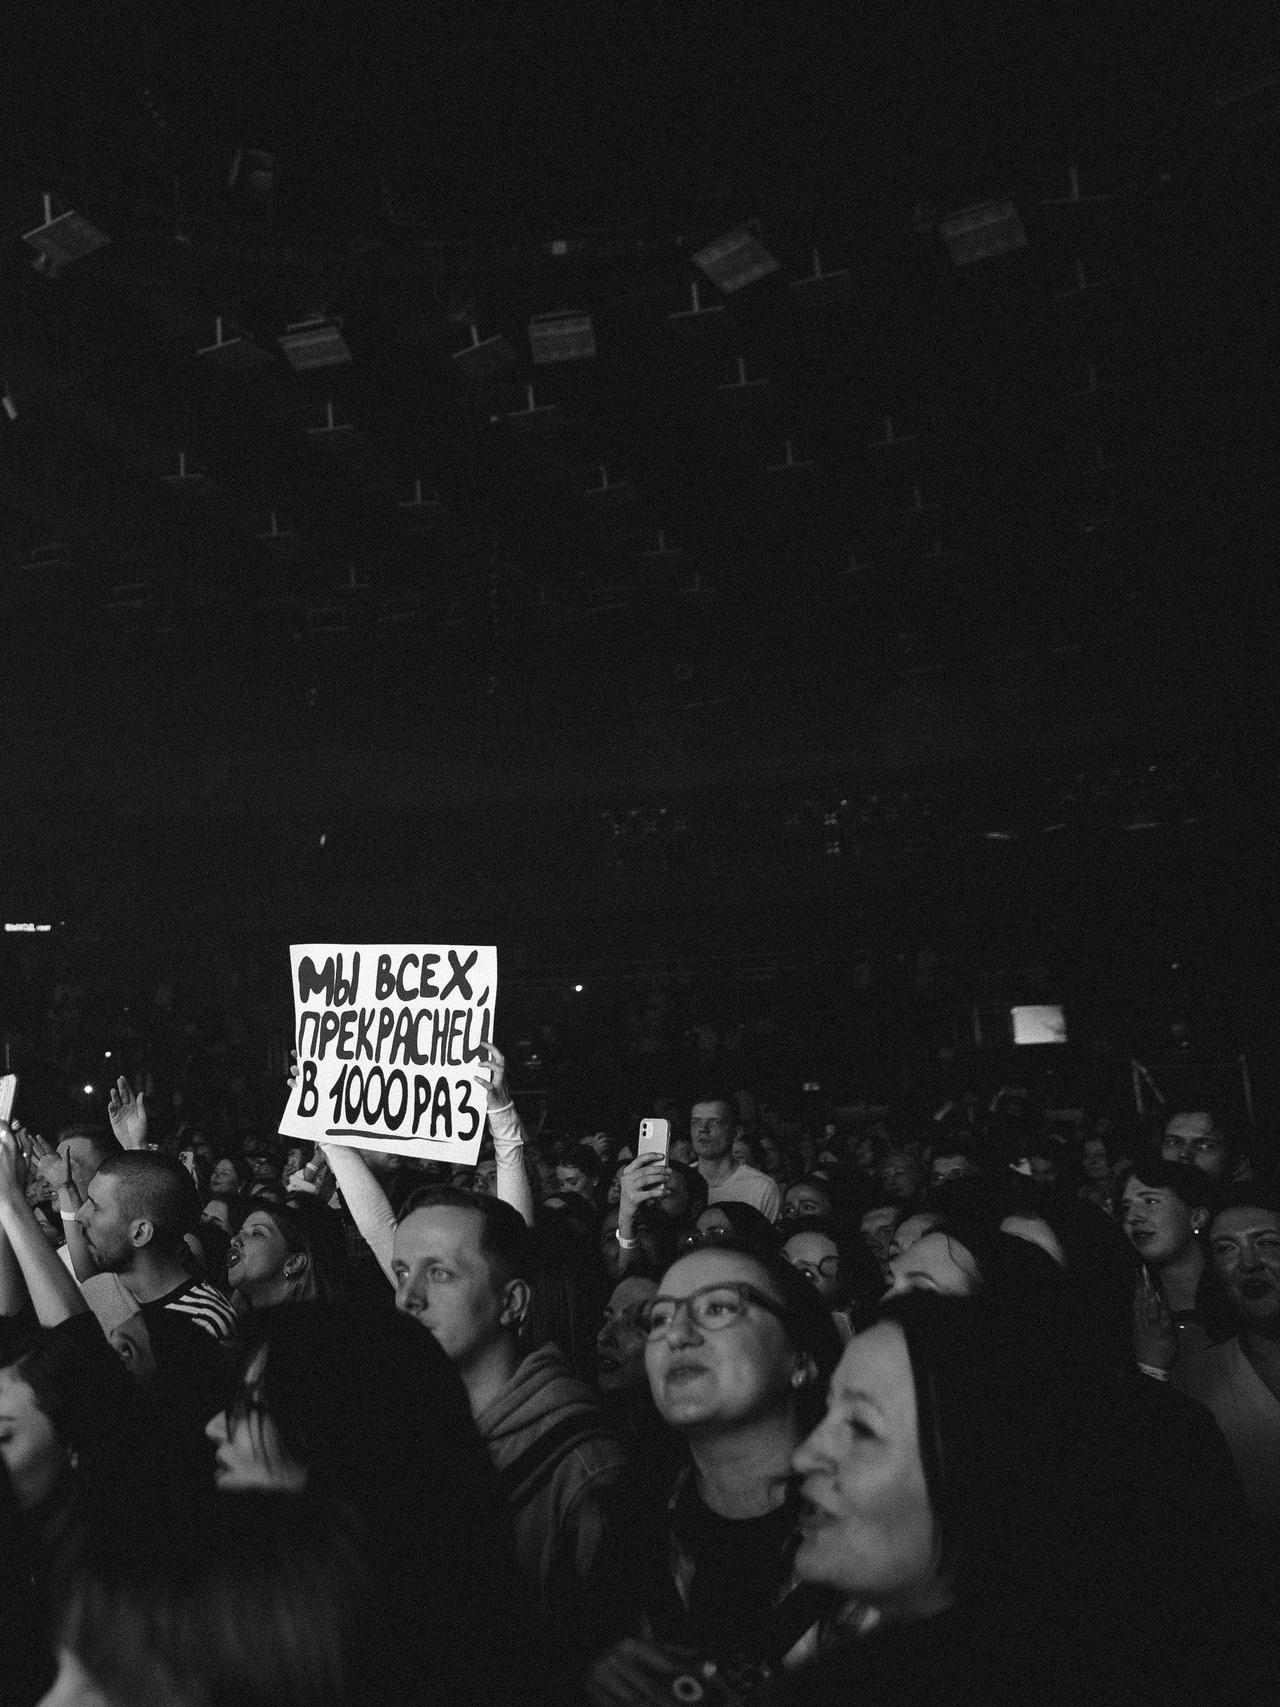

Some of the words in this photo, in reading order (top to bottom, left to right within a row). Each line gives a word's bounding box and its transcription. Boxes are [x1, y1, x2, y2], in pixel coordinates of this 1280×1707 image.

[298, 951, 361, 1007] МЫ
[297, 1060, 320, 1118] В
[329, 1063, 409, 1132] 1000
[411, 1074, 480, 1141] РАЗ
